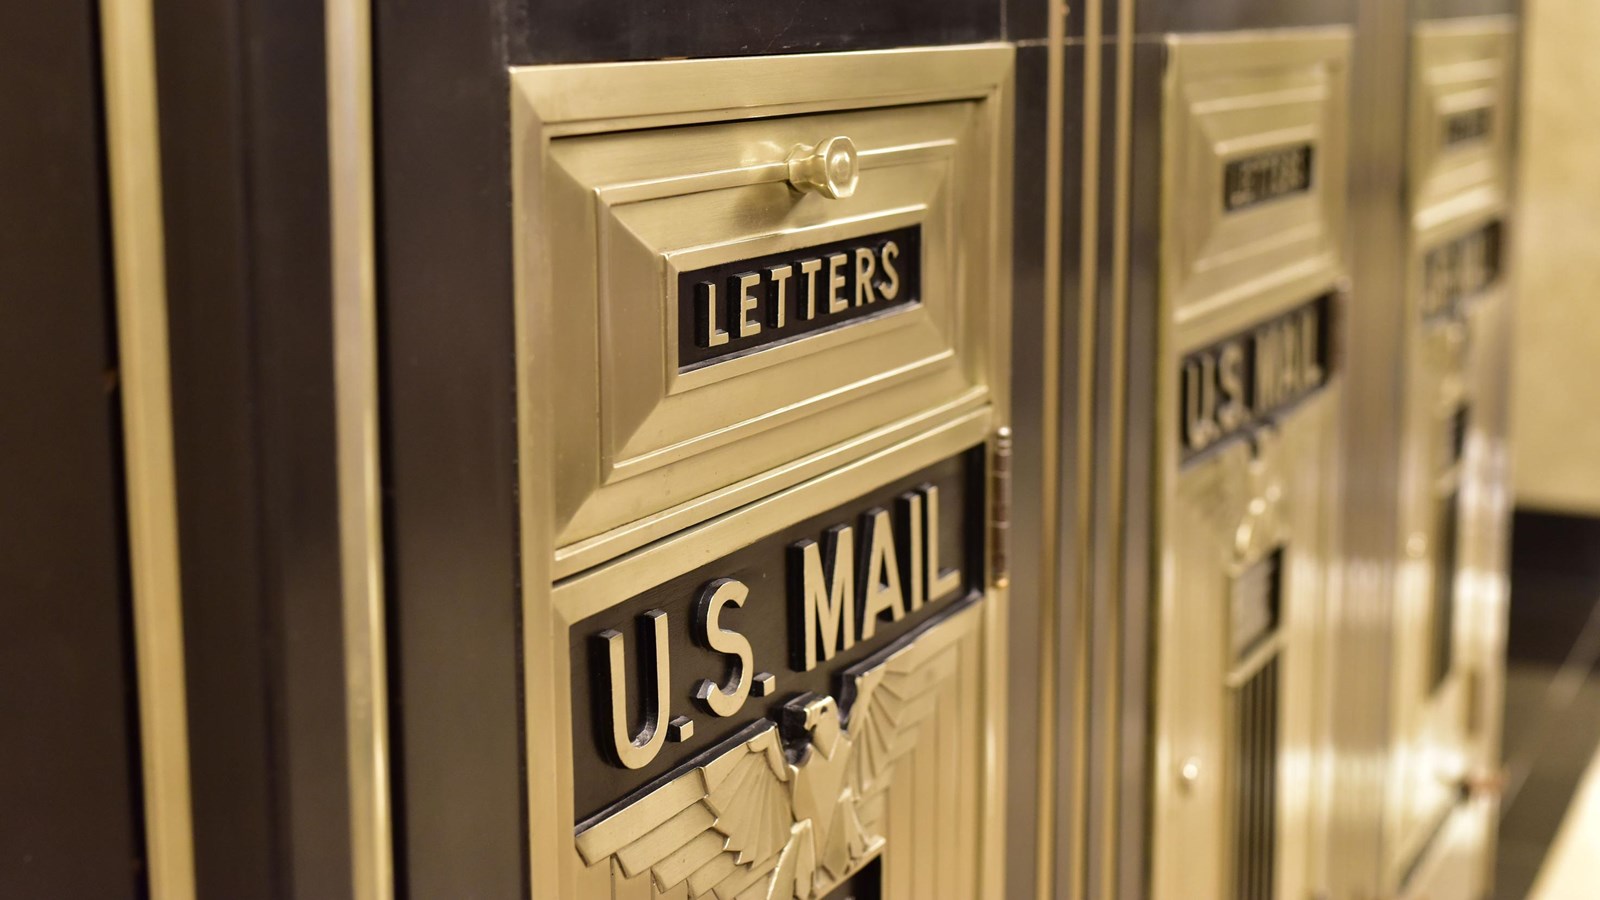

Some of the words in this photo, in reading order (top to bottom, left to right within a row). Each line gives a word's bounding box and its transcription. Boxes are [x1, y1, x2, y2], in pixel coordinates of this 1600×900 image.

[699, 240, 901, 348] LETTERS
[596, 578, 776, 770] U.S.
[791, 484, 960, 671] MAIL
